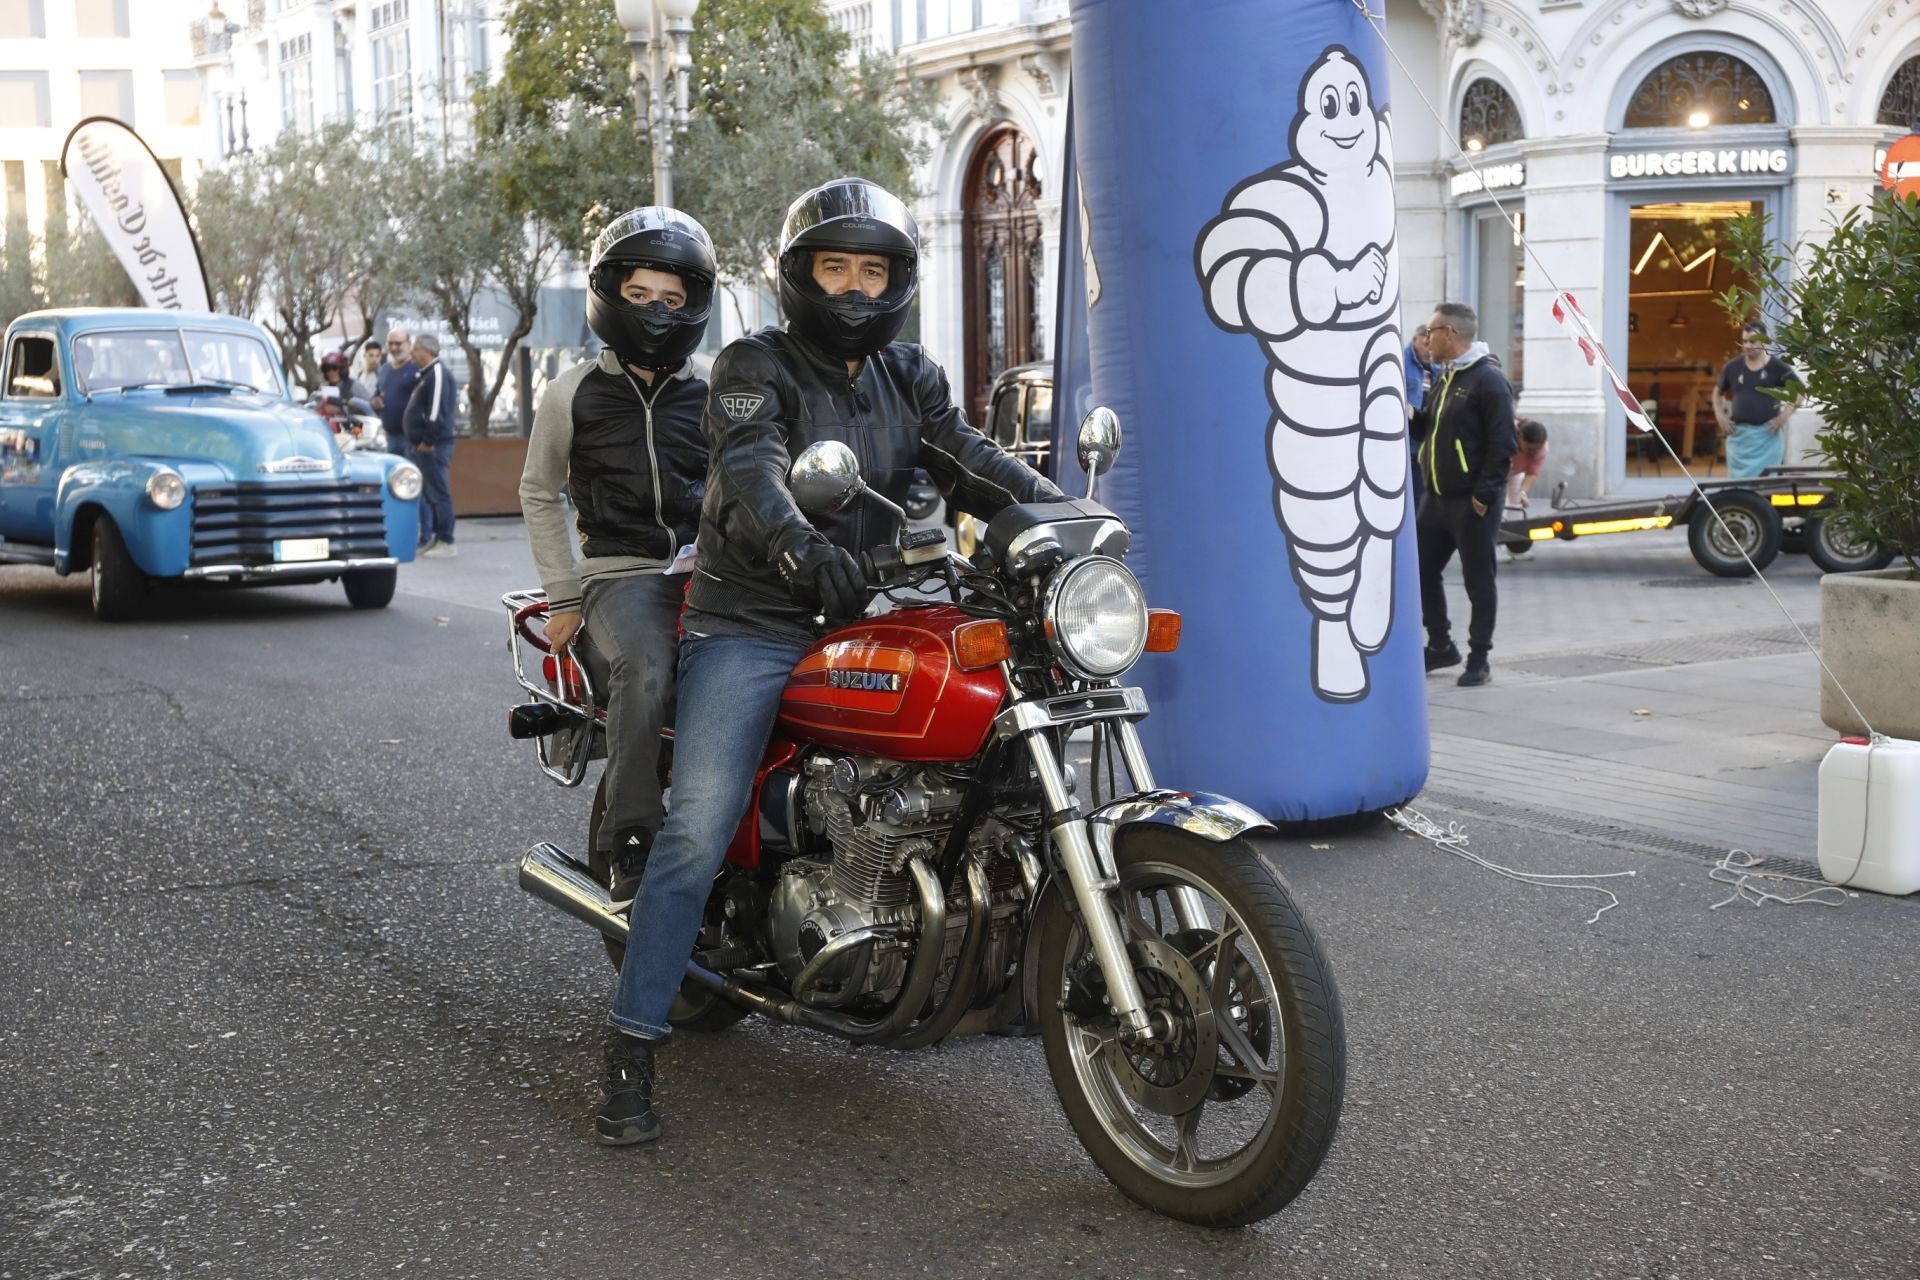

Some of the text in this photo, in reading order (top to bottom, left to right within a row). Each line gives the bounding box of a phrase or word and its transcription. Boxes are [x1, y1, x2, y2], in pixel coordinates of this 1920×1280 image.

[1610, 149, 1788, 178] BURGER KING
[829, 669, 899, 691] SUZUKI
